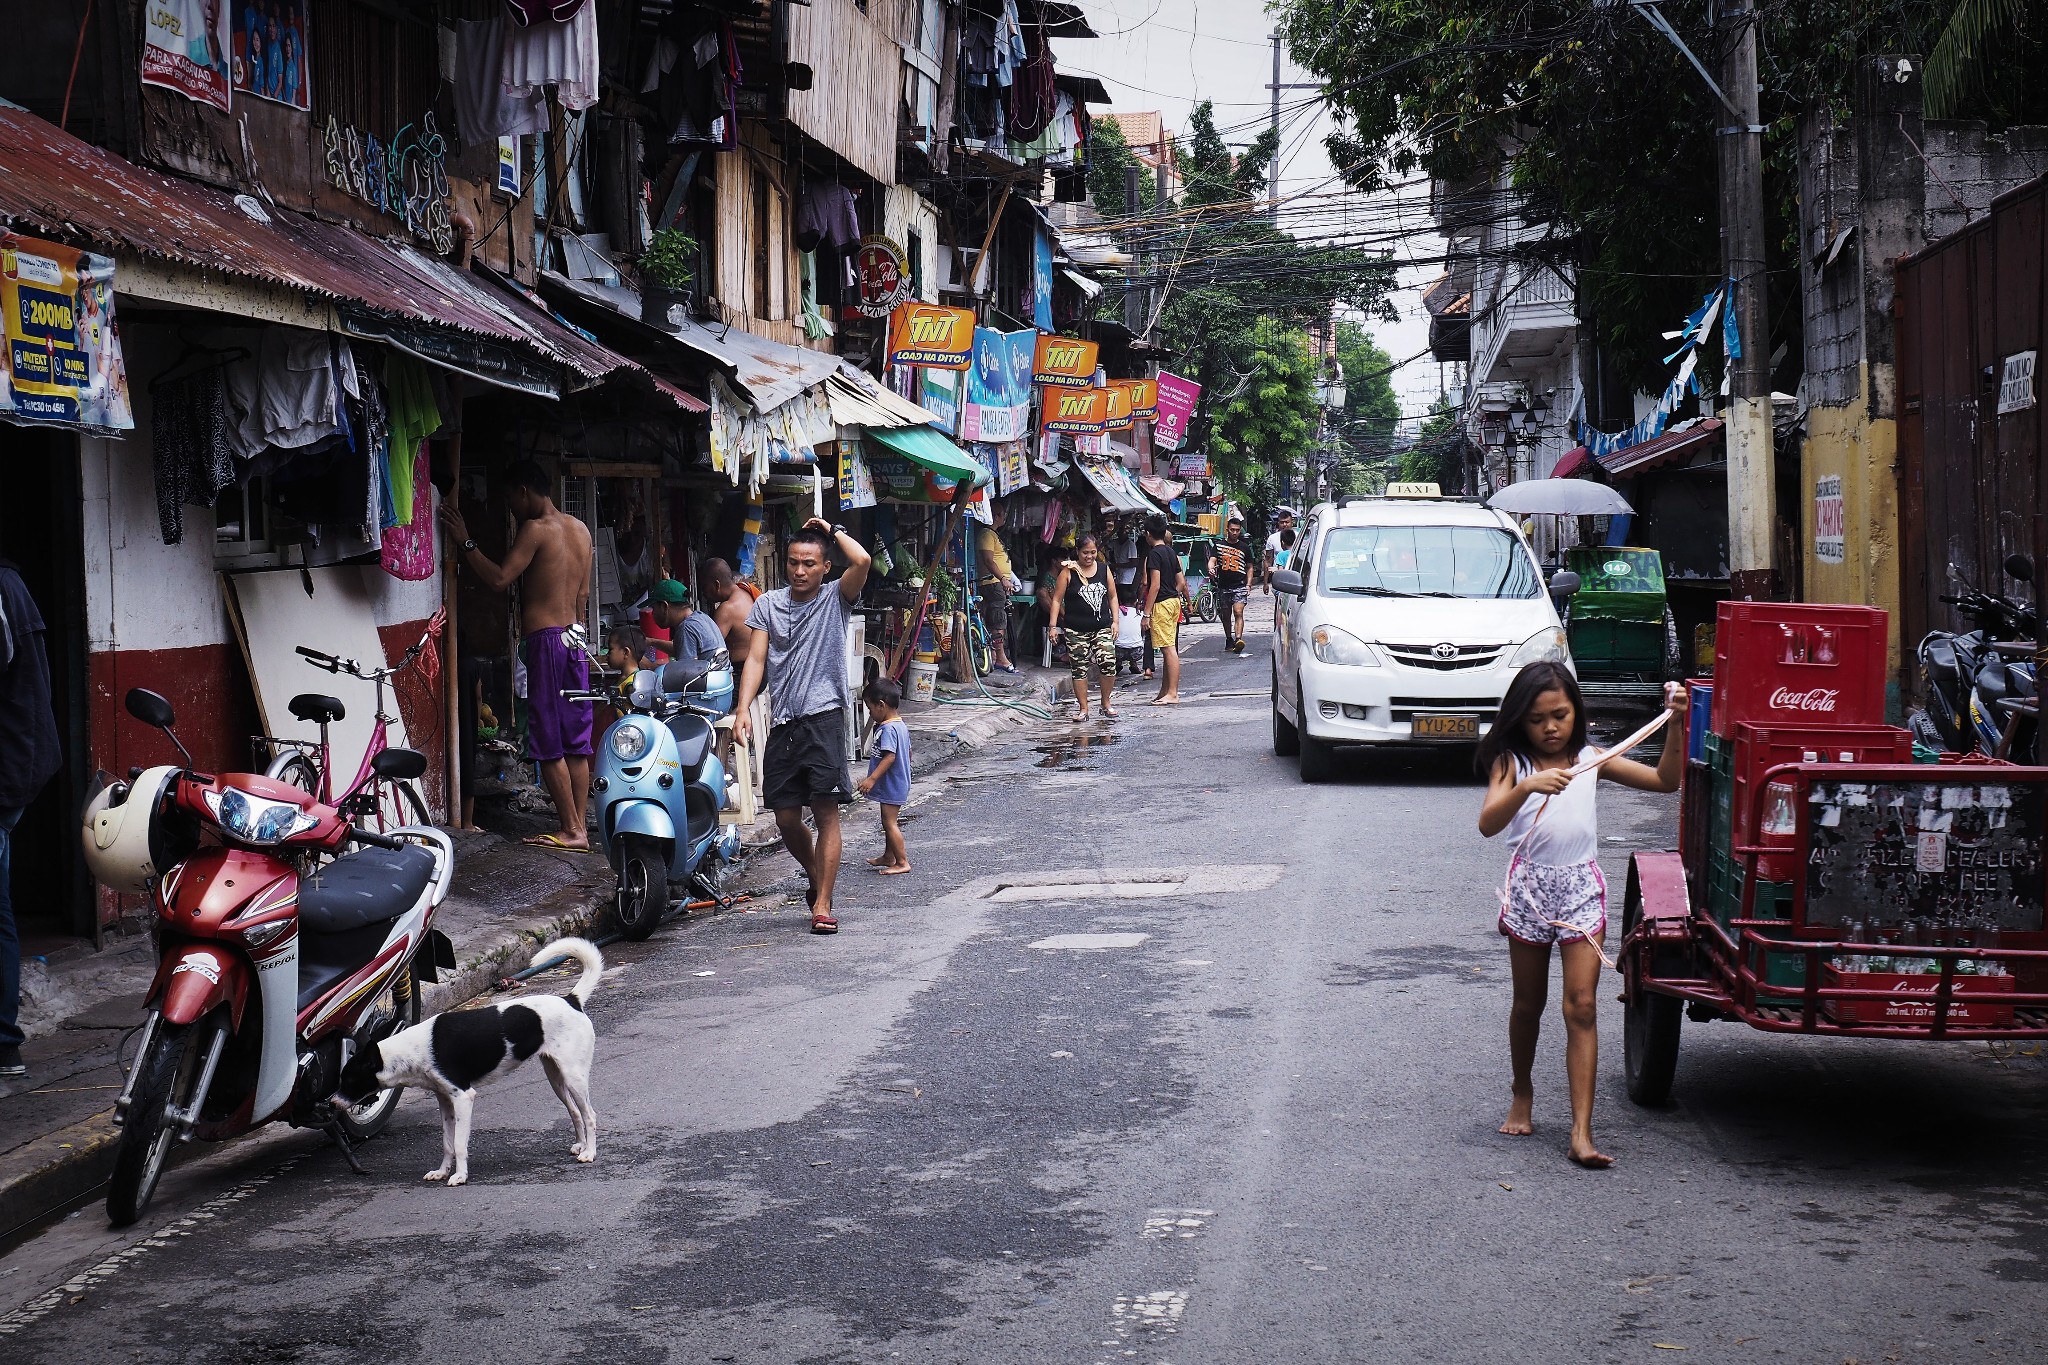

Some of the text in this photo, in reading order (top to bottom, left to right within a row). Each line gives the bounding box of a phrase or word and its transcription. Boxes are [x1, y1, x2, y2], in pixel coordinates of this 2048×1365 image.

[150, 9, 184, 37] LOPEZ
[146, 47, 212, 83] PARA KAGAWAD
[30, 300, 73, 330] 200MB
[909, 315, 961, 344] TNT
[897, 351, 966, 364] LOAD NA DITO!
[1045, 346, 1086, 369] TNT
[1034, 374, 1089, 386] LOAD NA DITO!
[45, 404, 52, 412] to
[1058, 395, 1098, 418] TNT
[1136, 409, 1153, 417] DITO!
[1048, 422, 1102, 433] LOAD NA DITO!
[1109, 419, 1129, 427] DITO!
[1395, 485, 1429, 494] TAXI
[1607, 563, 1627, 572] 147
[1769, 686, 1840, 712] Coca-Cola
[260, 953, 296, 971] REPSOL
[1886, 1008, 1898, 1016] 200
[1899, 1008, 1911, 1016] mL
[1915, 1008, 1928, 1017] 237
[1958, 1009, 1970, 1017] mL
